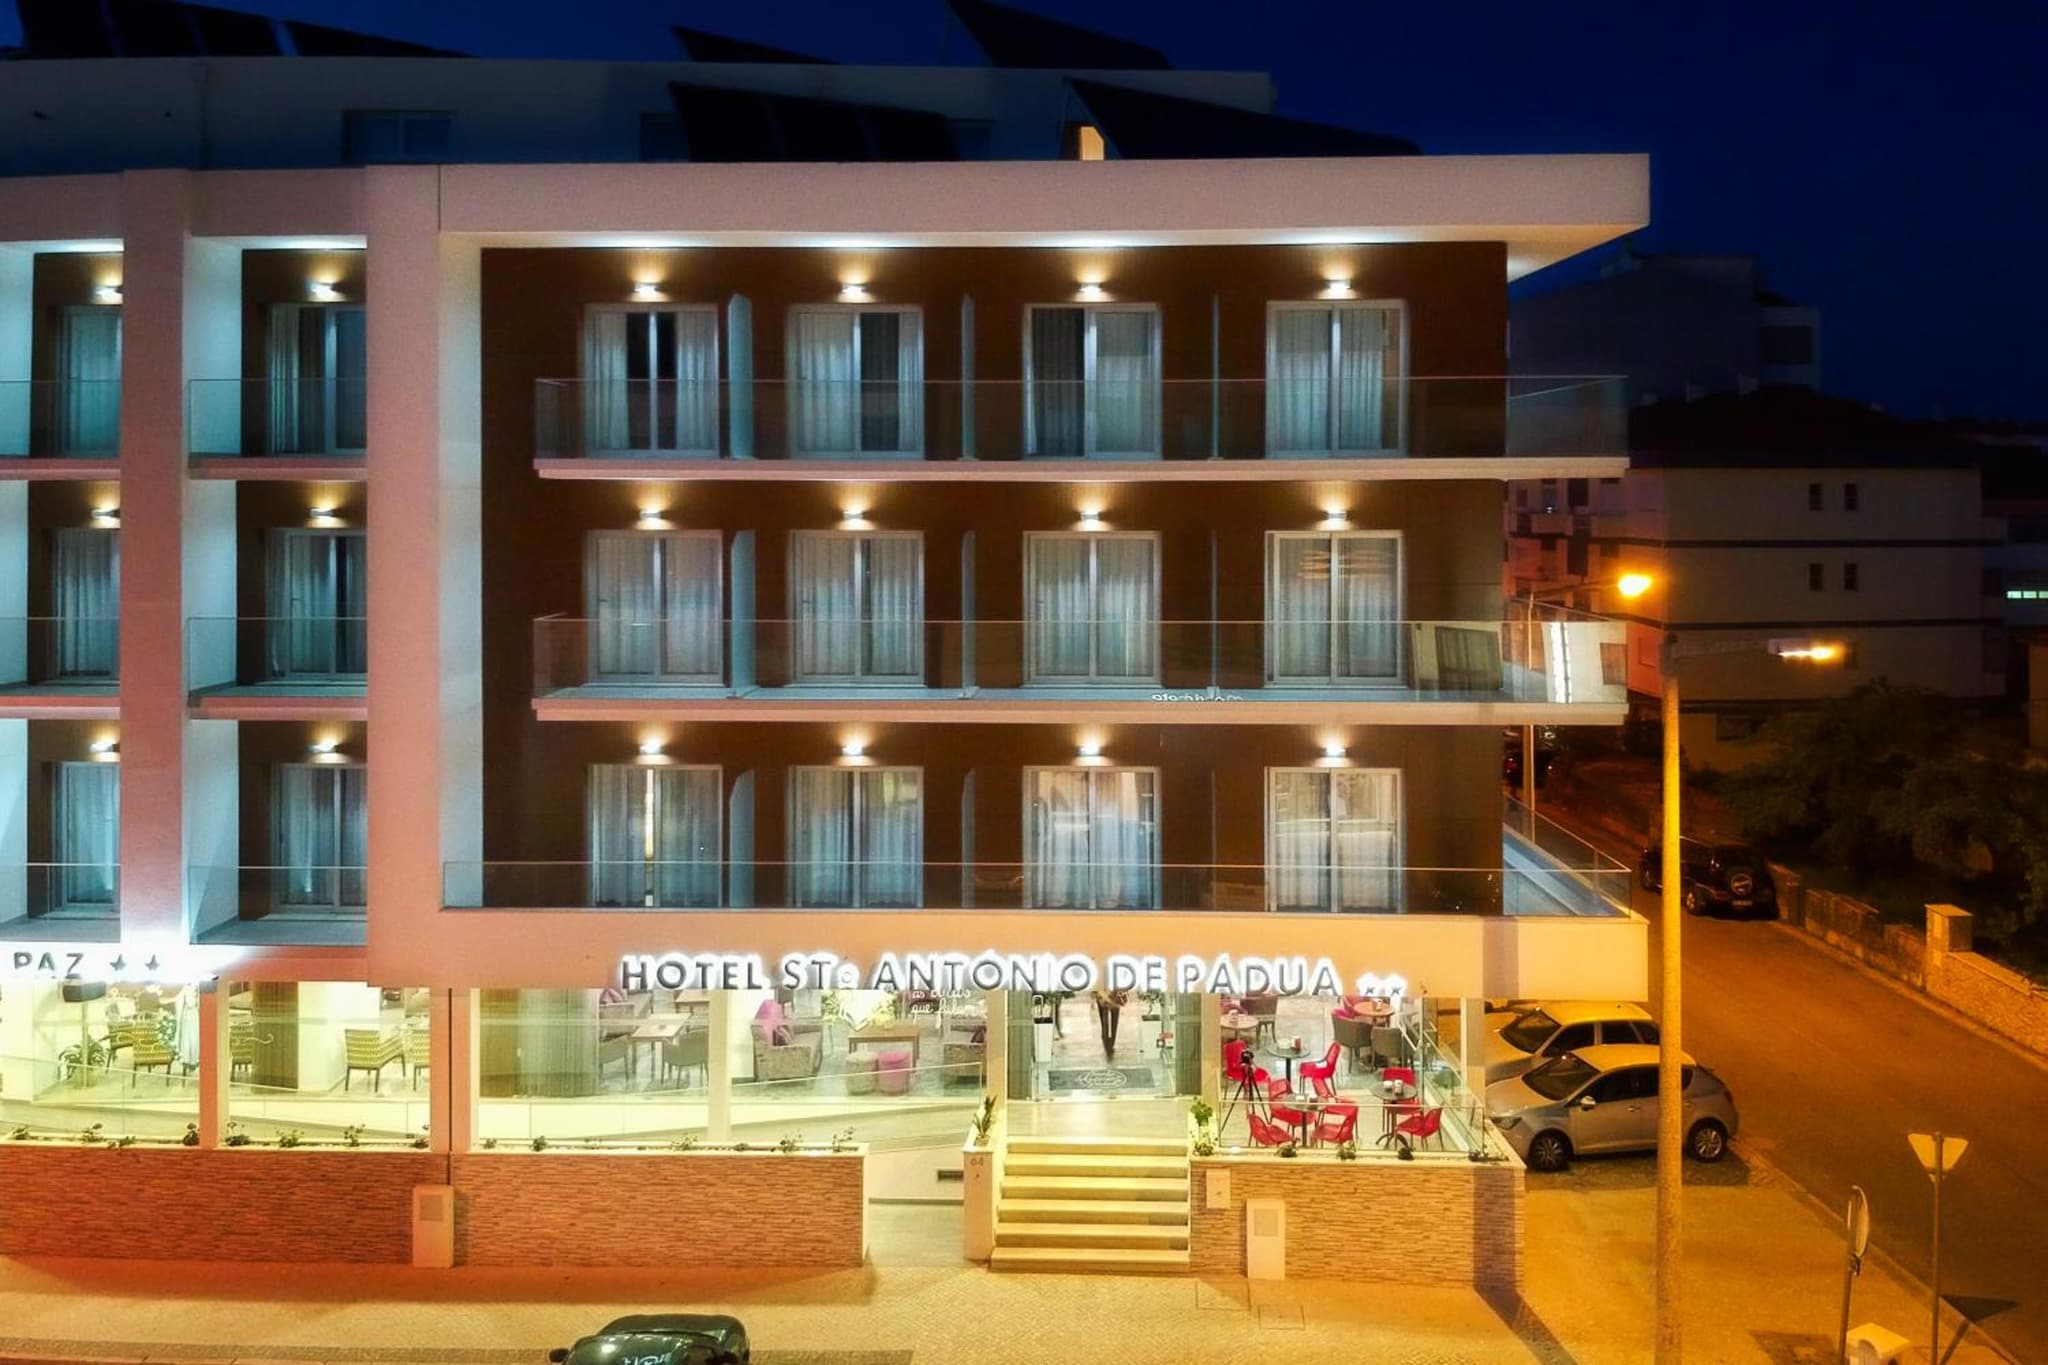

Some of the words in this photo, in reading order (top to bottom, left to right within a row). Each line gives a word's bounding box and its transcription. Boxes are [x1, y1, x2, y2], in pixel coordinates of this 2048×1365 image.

[14, 952, 84, 975] PAZ
[621, 960, 763, 990] HOTEL
[1112, 960, 1163, 992] DE
